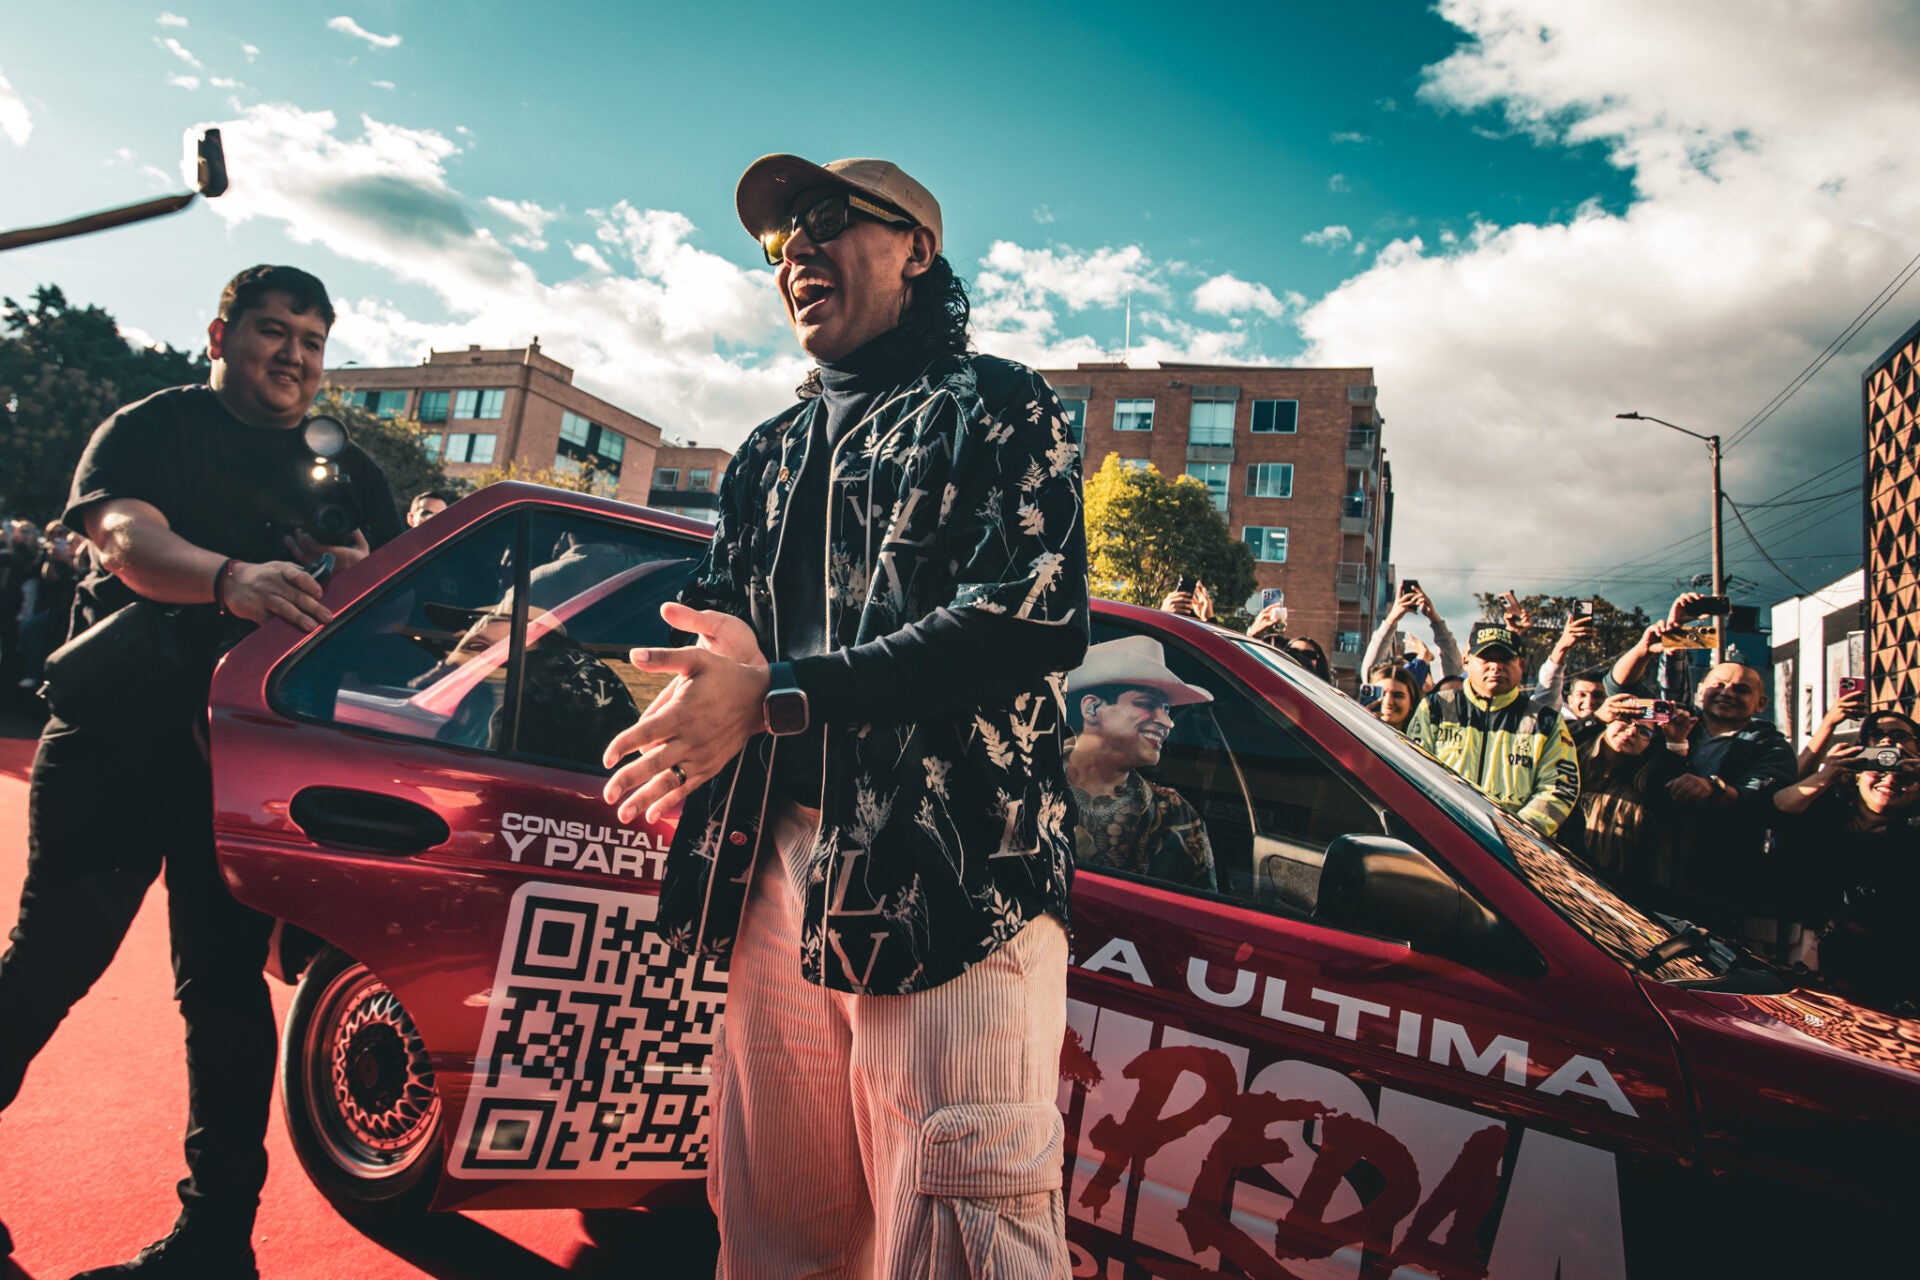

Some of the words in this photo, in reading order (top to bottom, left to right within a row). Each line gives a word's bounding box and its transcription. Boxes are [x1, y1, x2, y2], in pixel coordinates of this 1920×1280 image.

[1508, 753, 1533, 769] OPEN
[500, 830, 538, 863] Y
[501, 812, 652, 849] CONSULTA
[1068, 937, 1154, 988] A
